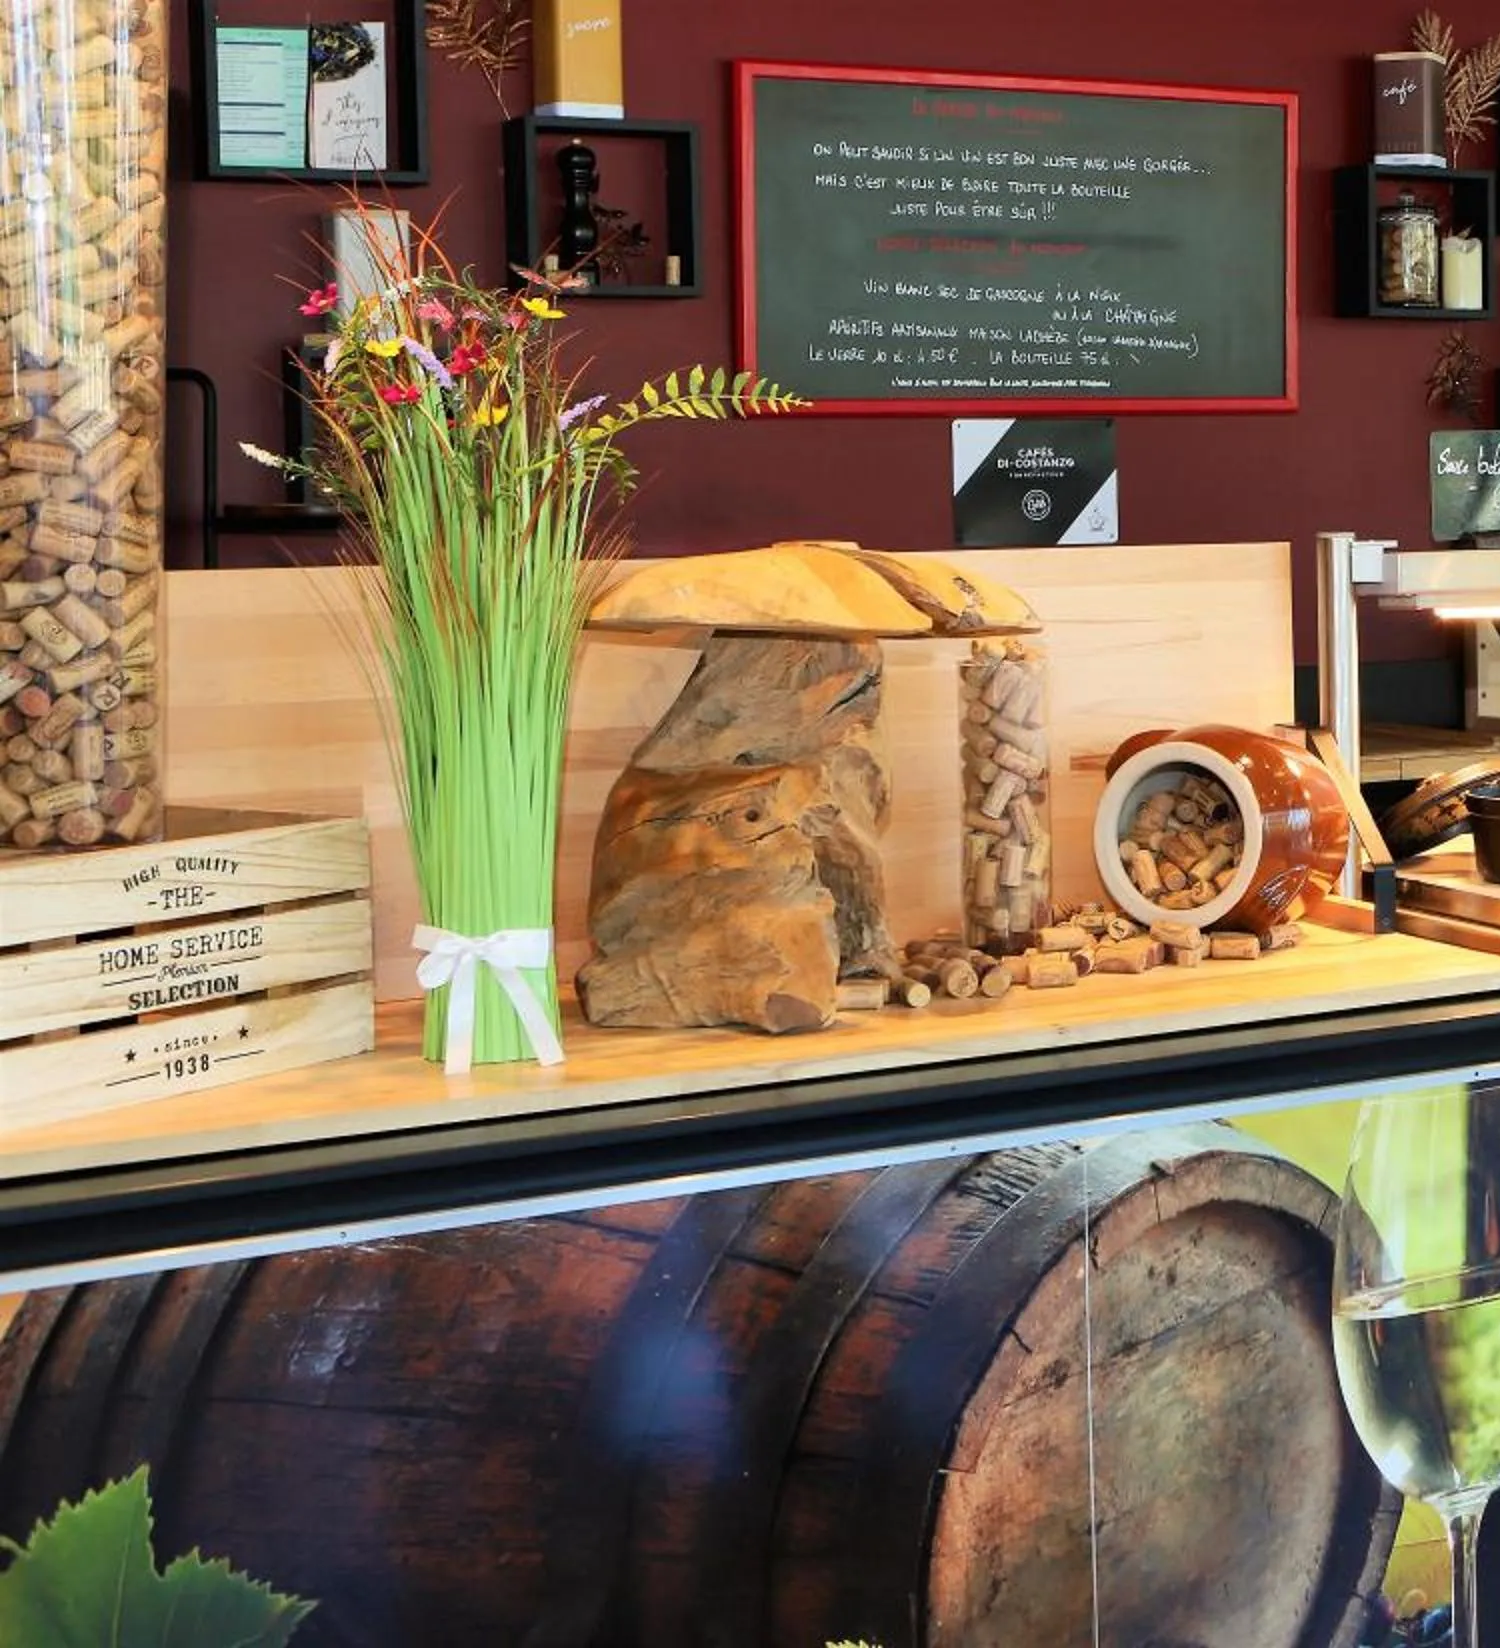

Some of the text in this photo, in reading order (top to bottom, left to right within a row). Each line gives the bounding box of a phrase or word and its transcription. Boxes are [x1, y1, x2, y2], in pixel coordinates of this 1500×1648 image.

[987, 152, 1009, 165] EST
[1013, 151, 1035, 165] BON
[1041, 155, 1078, 170] JUSTE
[941, 177, 953, 191] DE
[1007, 180, 1047, 195] TOUTE
[1051, 183, 1065, 196] LA
[1071, 183, 1130, 199] BOUTEILLE
[890, 202, 928, 217] JUSTE
[935, 201, 965, 217] POUR
[1011, 350, 1072, 366] BOUTEILLE
[1017, 445, 1055, 459] CAFÉS
[997, 457, 1076, 469] DI-COSTANZO
[122, 856, 240, 893] HIGH QUALITY
[97, 925, 264, 975] HOME SERVICE
[127, 974, 240, 1011] SELECTION
[164, 1053, 210, 1082] 1938
